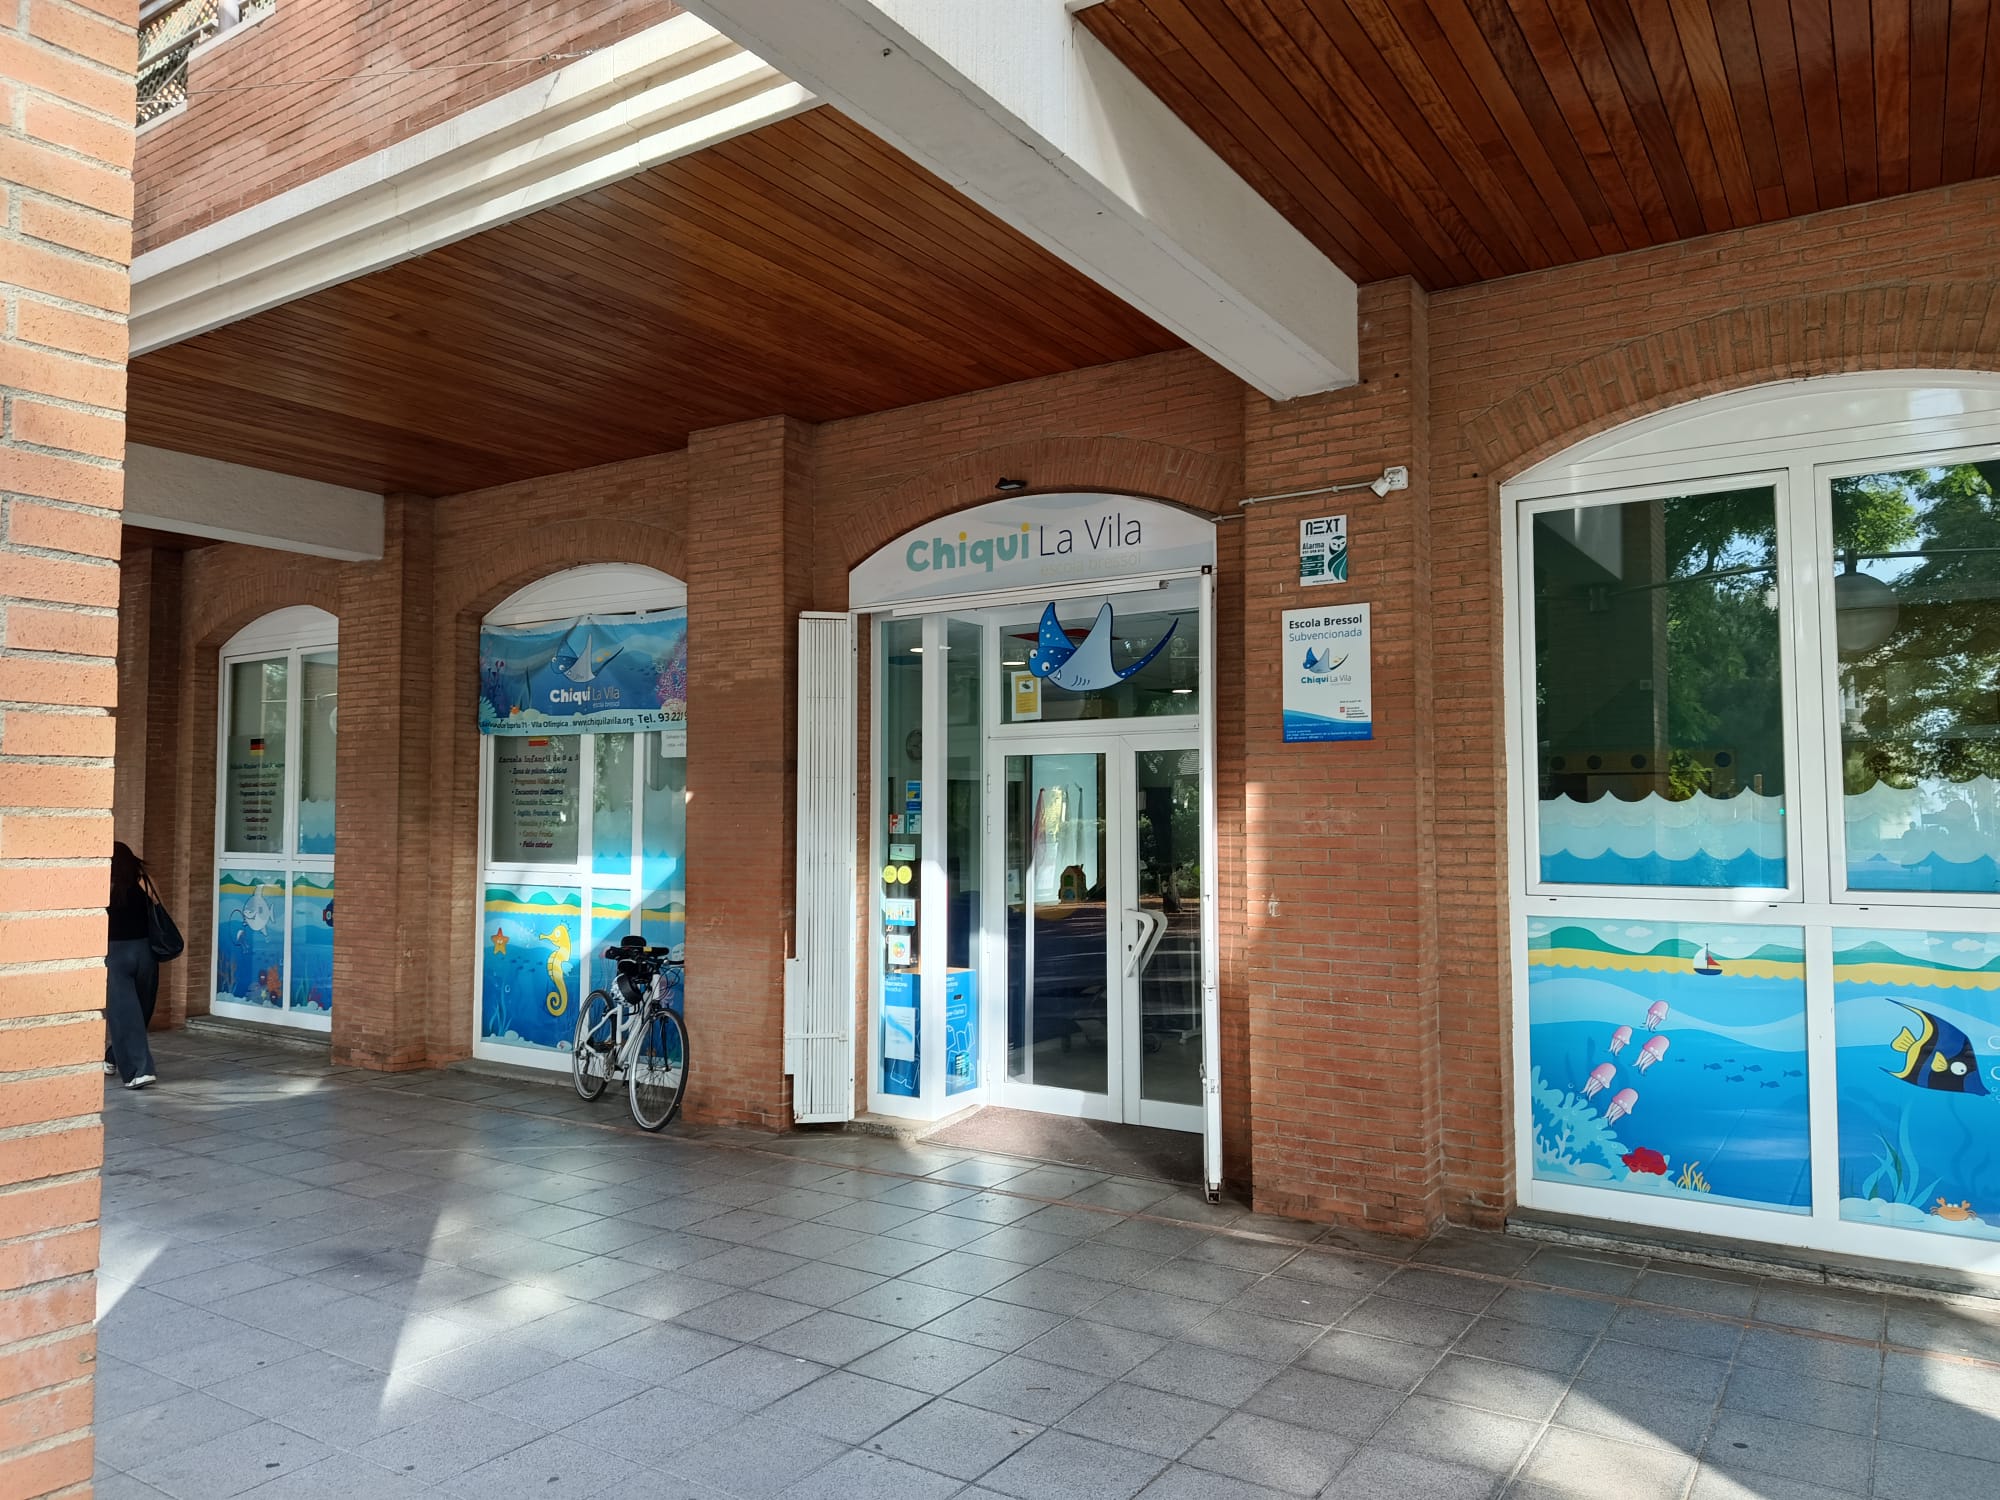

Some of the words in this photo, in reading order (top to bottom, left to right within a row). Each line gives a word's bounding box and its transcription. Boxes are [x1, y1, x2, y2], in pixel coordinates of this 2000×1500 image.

[906, 522, 1030, 573] Chiqui
[1039, 525, 1073, 557] La
[1084, 512, 1142, 551] Vila
[1289, 618, 1321, 629] Escola
[1324, 613, 1363, 626] Bressol
[1289, 628, 1363, 642] Subvencionada
[1300, 675, 1329, 685] Chiqui
[1340, 674, 1352, 682] Vila
[549, 686, 591, 705] Chiqui
[592, 688, 602, 700] La
[603, 686, 620, 700] Vila
[638, 713, 656, 724] Tel.
[658, 712, 669, 723] 93
